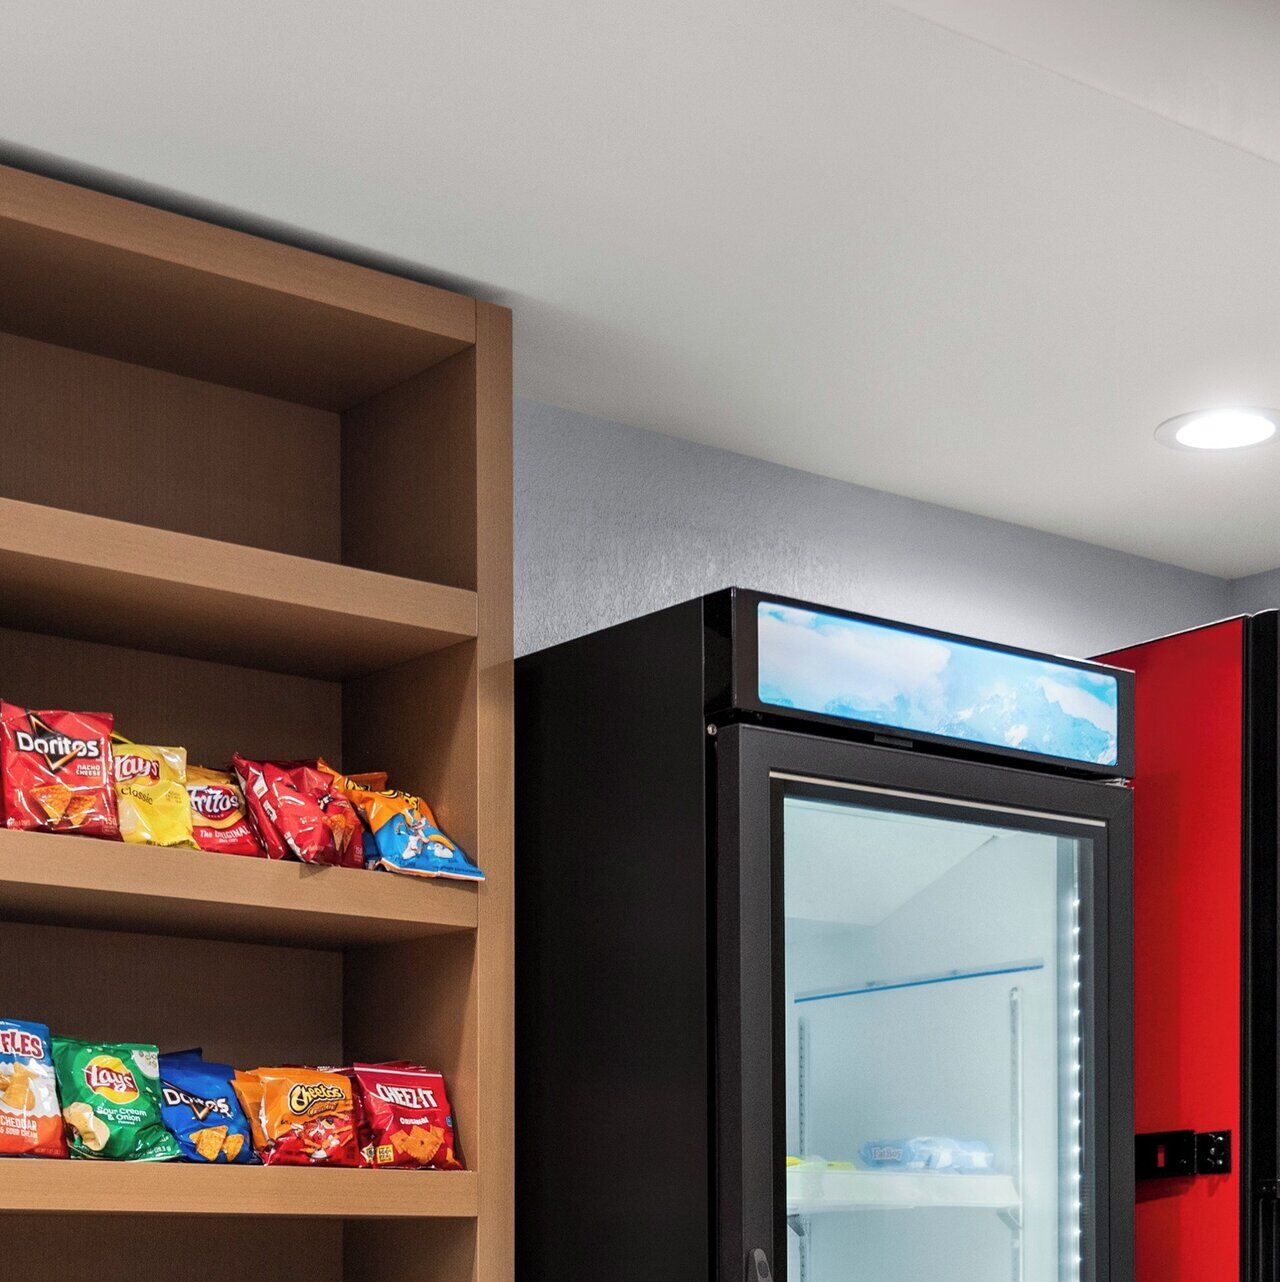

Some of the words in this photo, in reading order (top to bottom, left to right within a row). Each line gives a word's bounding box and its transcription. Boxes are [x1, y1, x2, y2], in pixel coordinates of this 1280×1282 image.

[16, 730, 100, 758] Doritos
[120, 786, 154, 806] Classic
[186, 783, 239, 815] Fritos
[288, 1082, 346, 1115] Cheetos
[96, 1105, 118, 1116] Sour
[119, 1107, 148, 1118] Cream
[116, 1113, 142, 1123] Onion
